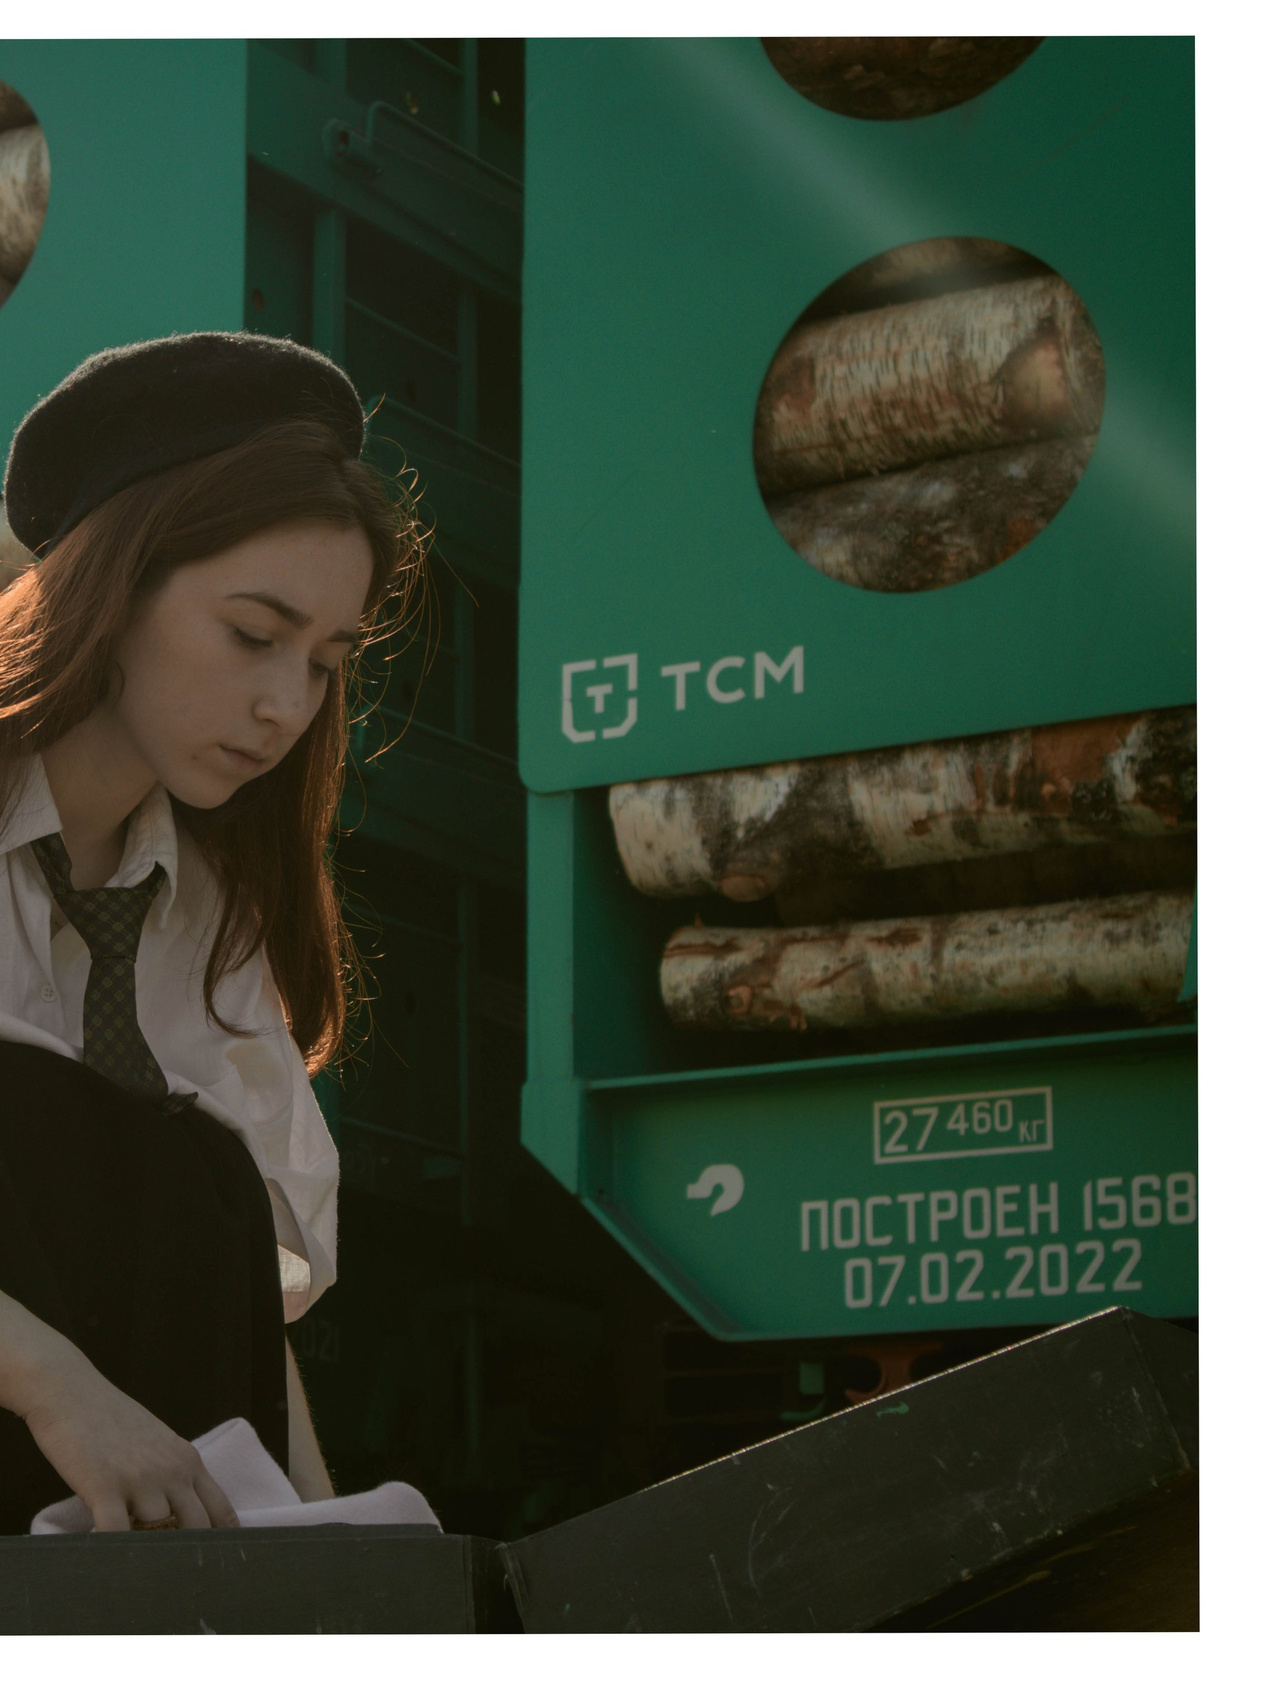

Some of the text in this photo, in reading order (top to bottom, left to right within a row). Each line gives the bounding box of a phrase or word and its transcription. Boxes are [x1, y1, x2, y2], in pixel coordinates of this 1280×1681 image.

[801, 1172, 1197, 1252] ПОСТРОЕН 1568
[844, 1238, 1142, 1308] 07.02.2022
